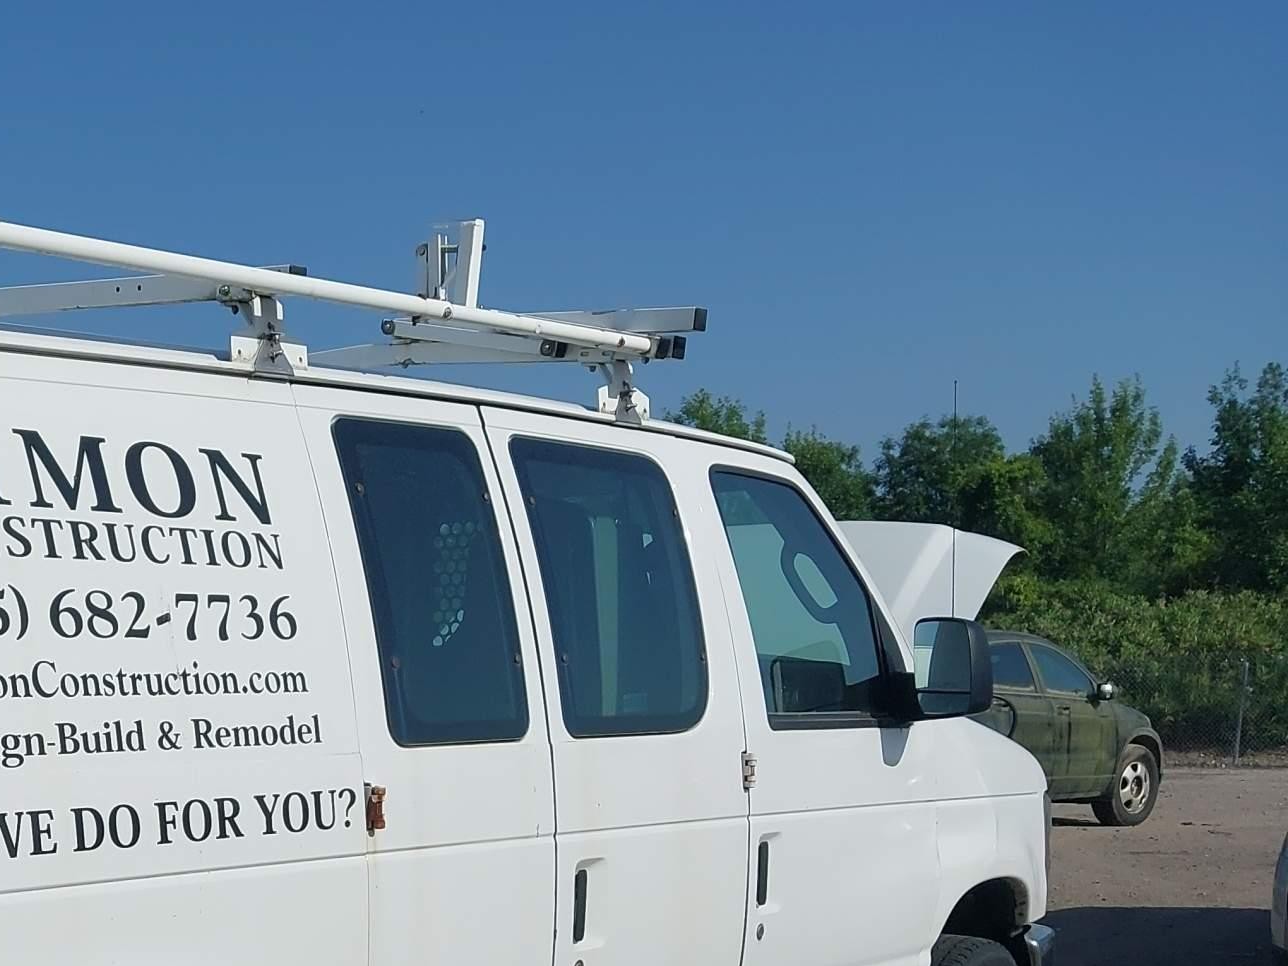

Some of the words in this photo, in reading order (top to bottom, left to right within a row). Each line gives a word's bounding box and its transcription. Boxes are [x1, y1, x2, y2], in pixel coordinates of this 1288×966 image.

[49, 588, 298, 641] 682-7736
[157, 720, 182, 751] &
[191, 714, 322, 750] Remodel
[70, 804, 141, 852] DO
[154, 796, 244, 846] FOR
[254, 788, 356, 836] YOU?
